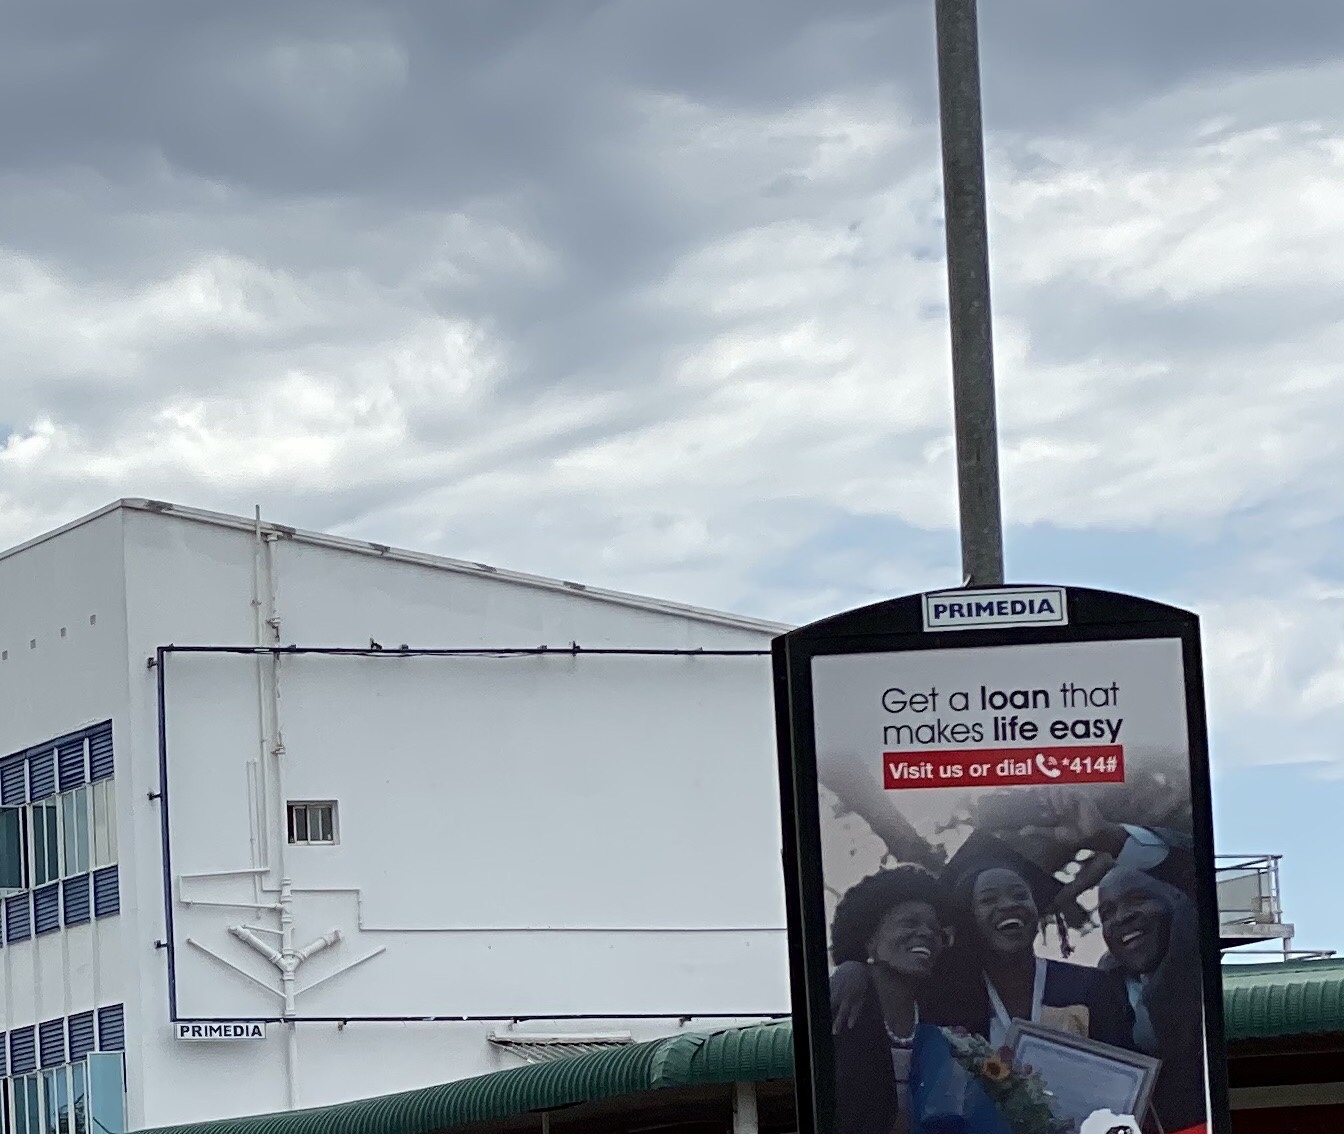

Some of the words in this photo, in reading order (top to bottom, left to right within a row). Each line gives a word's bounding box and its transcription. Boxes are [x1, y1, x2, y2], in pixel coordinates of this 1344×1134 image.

[933, 598, 1056, 620] PRIMEDIA
[881, 686, 939, 714] Get
[948, 691, 970, 713] a
[980, 685, 1050, 711] loan
[1060, 681, 1120, 708] that
[883, 718, 984, 745] makes
[993, 715, 1039, 742] life
[1049, 717, 1124, 744] easy
[888, 762, 934, 780] Visit
[938, 763, 964, 779] us
[969, 762, 991, 778] or
[995, 758, 1032, 777] dial
[179, 1024, 263, 1038] PRIMEDIA
